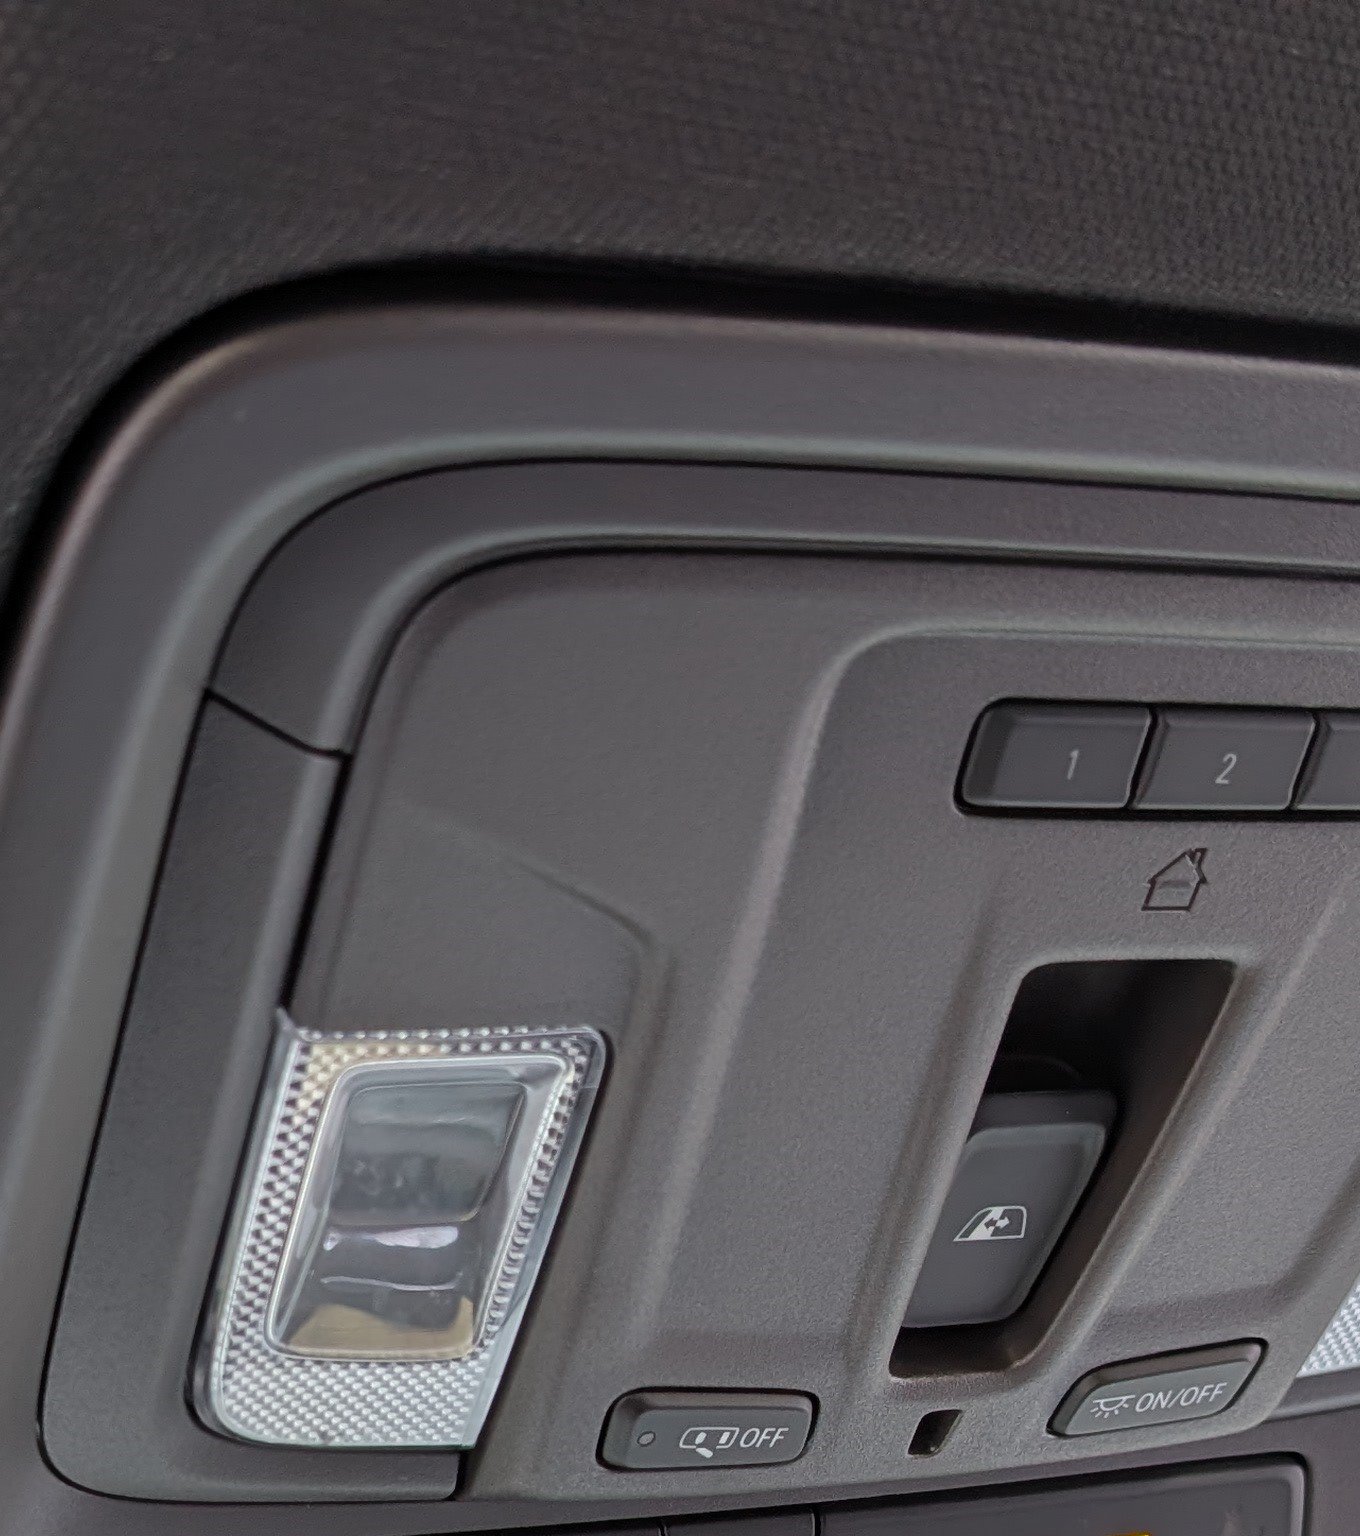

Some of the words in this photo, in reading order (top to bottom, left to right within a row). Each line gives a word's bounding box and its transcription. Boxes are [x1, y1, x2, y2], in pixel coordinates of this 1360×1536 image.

[1066, 749, 1081, 781] 1
[1214, 752, 1238, 786] 2
[1133, 1382, 1228, 1413] ON/OFF
[739, 1427, 789, 1449] OFF
